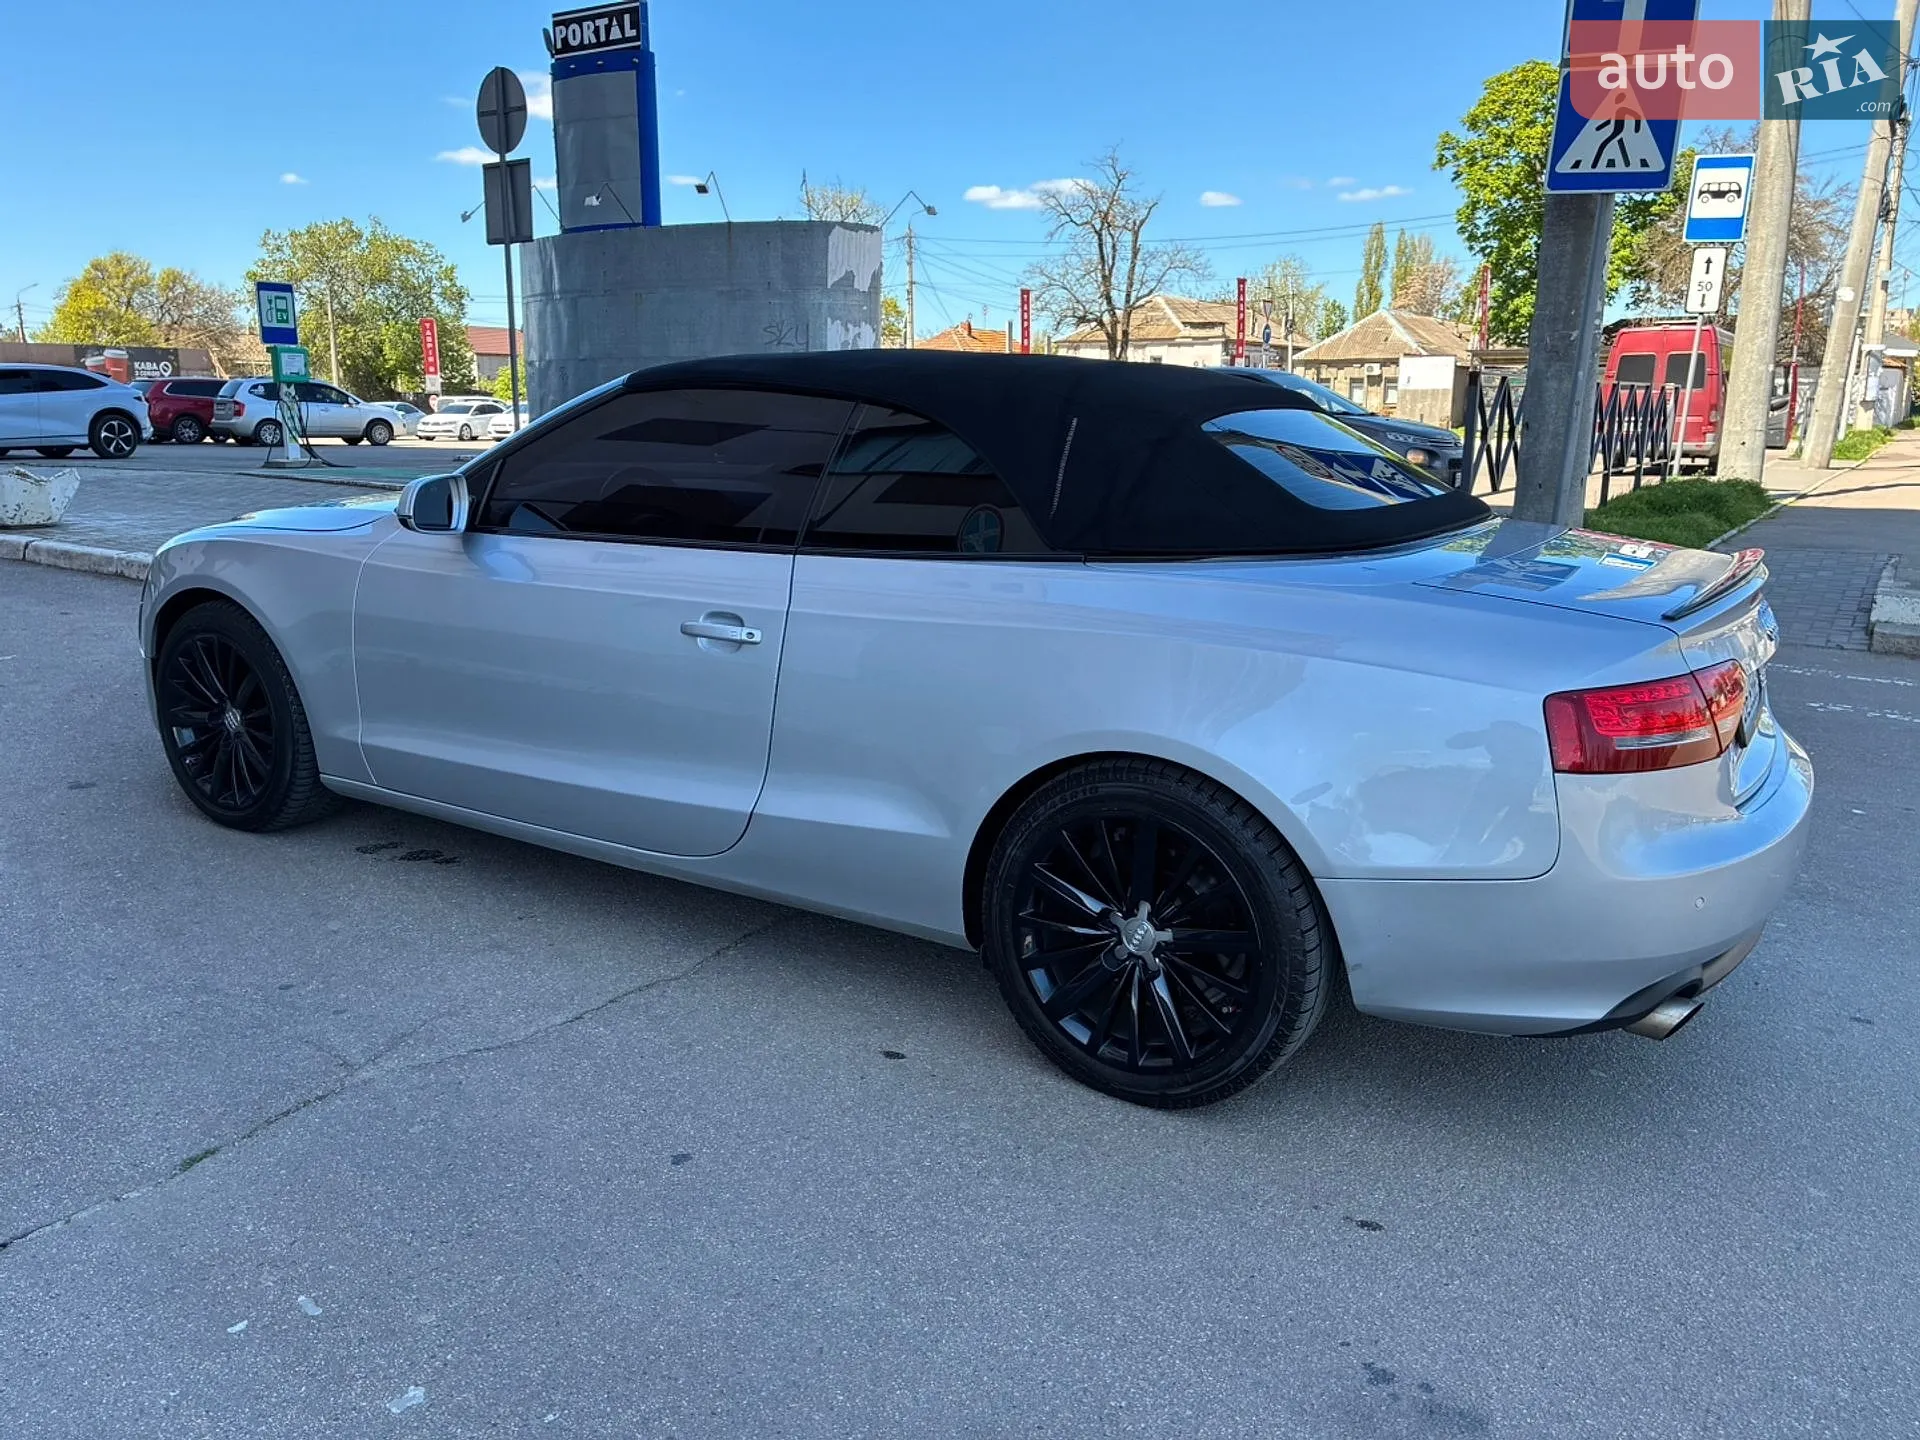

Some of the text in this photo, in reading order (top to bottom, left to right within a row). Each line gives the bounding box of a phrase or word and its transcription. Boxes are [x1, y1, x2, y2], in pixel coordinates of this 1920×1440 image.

[555, 13, 636, 49] PORTAL
[1697, 281, 1713, 292] 50
[277, 311, 288, 321] EV
